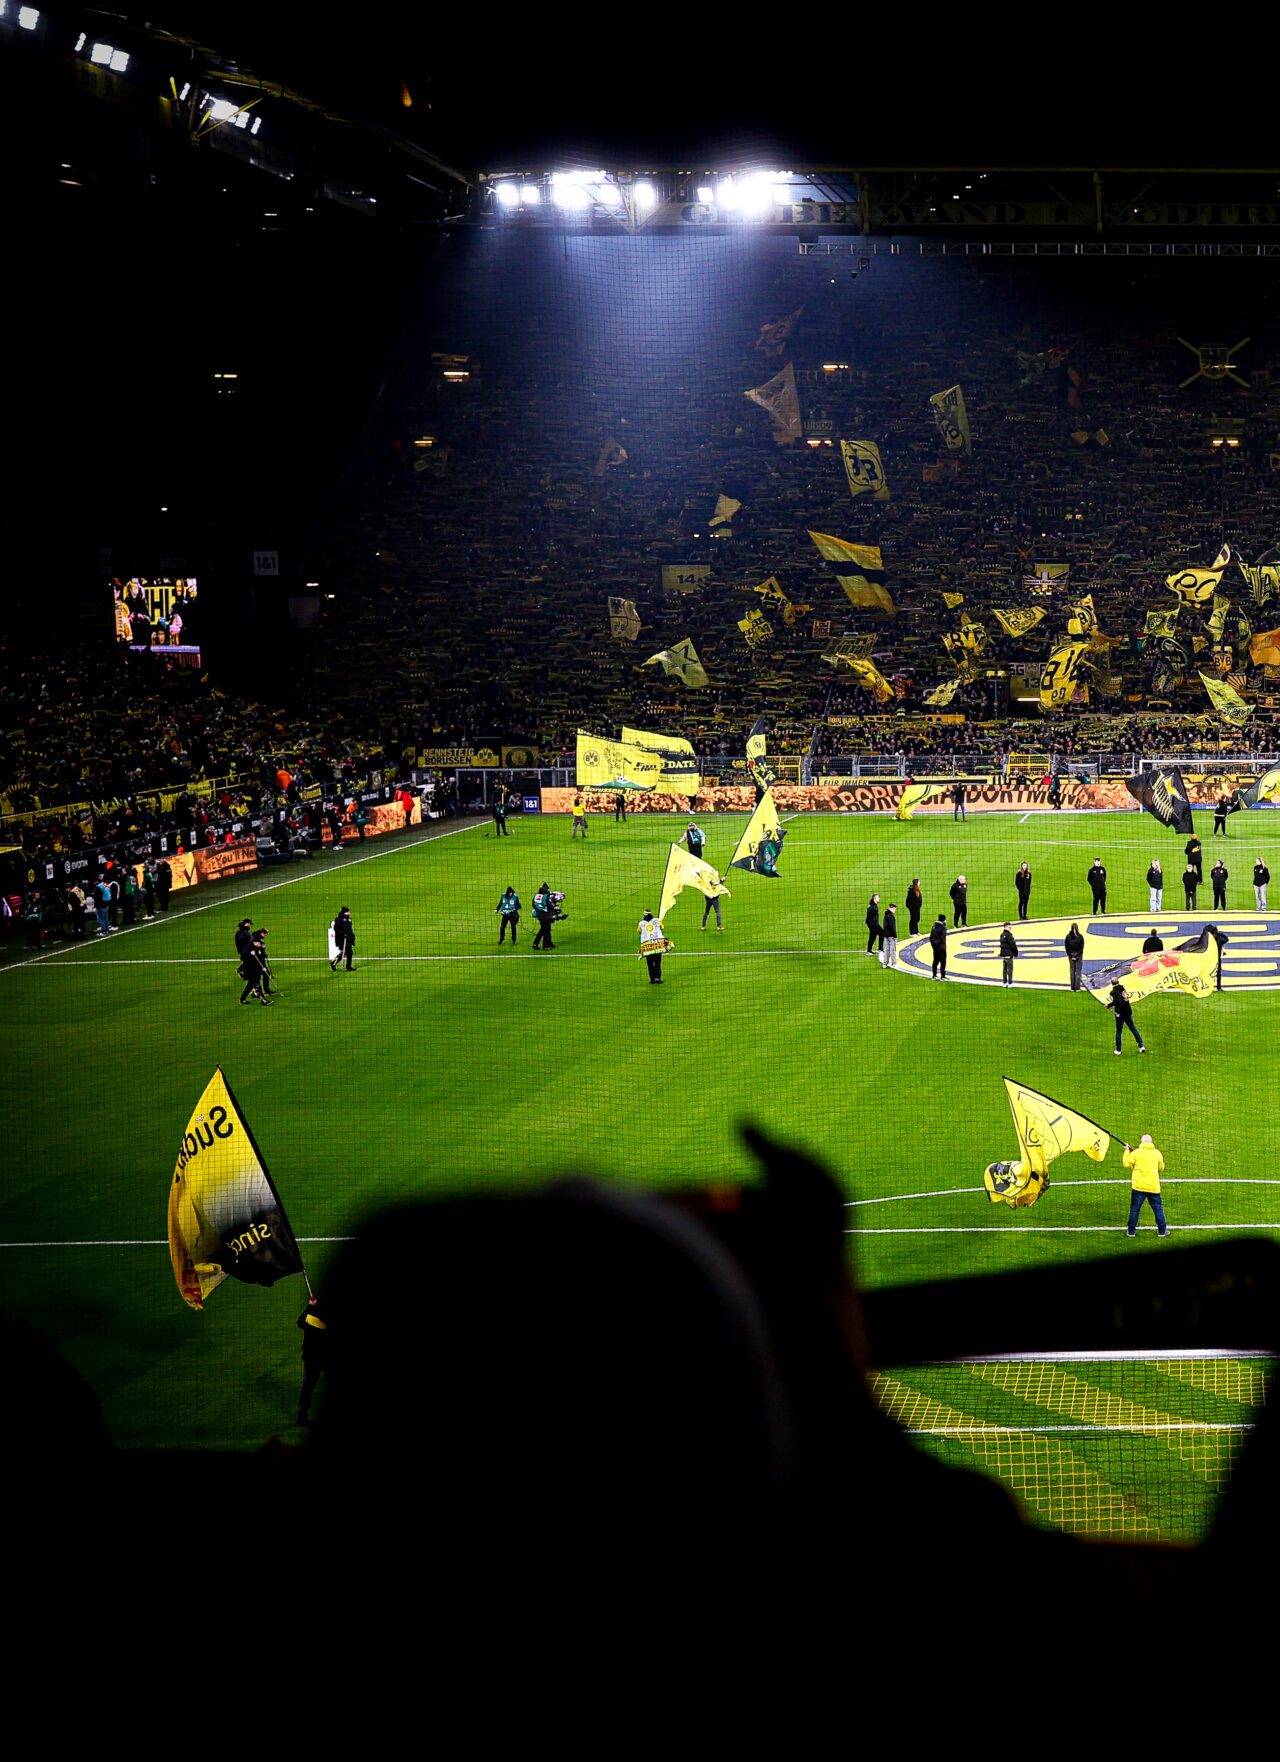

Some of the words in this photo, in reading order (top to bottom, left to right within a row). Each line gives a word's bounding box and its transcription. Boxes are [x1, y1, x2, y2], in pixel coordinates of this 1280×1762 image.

[257, 556, 276, 569] 1&1
[423, 748, 475, 757] RENNSTEIG
[426, 757, 472, 766] BORUSSEN
[667, 760, 696, 769] DATE
[839, 785, 956, 811] BORUIA
[524, 799, 538, 809] 1&1
